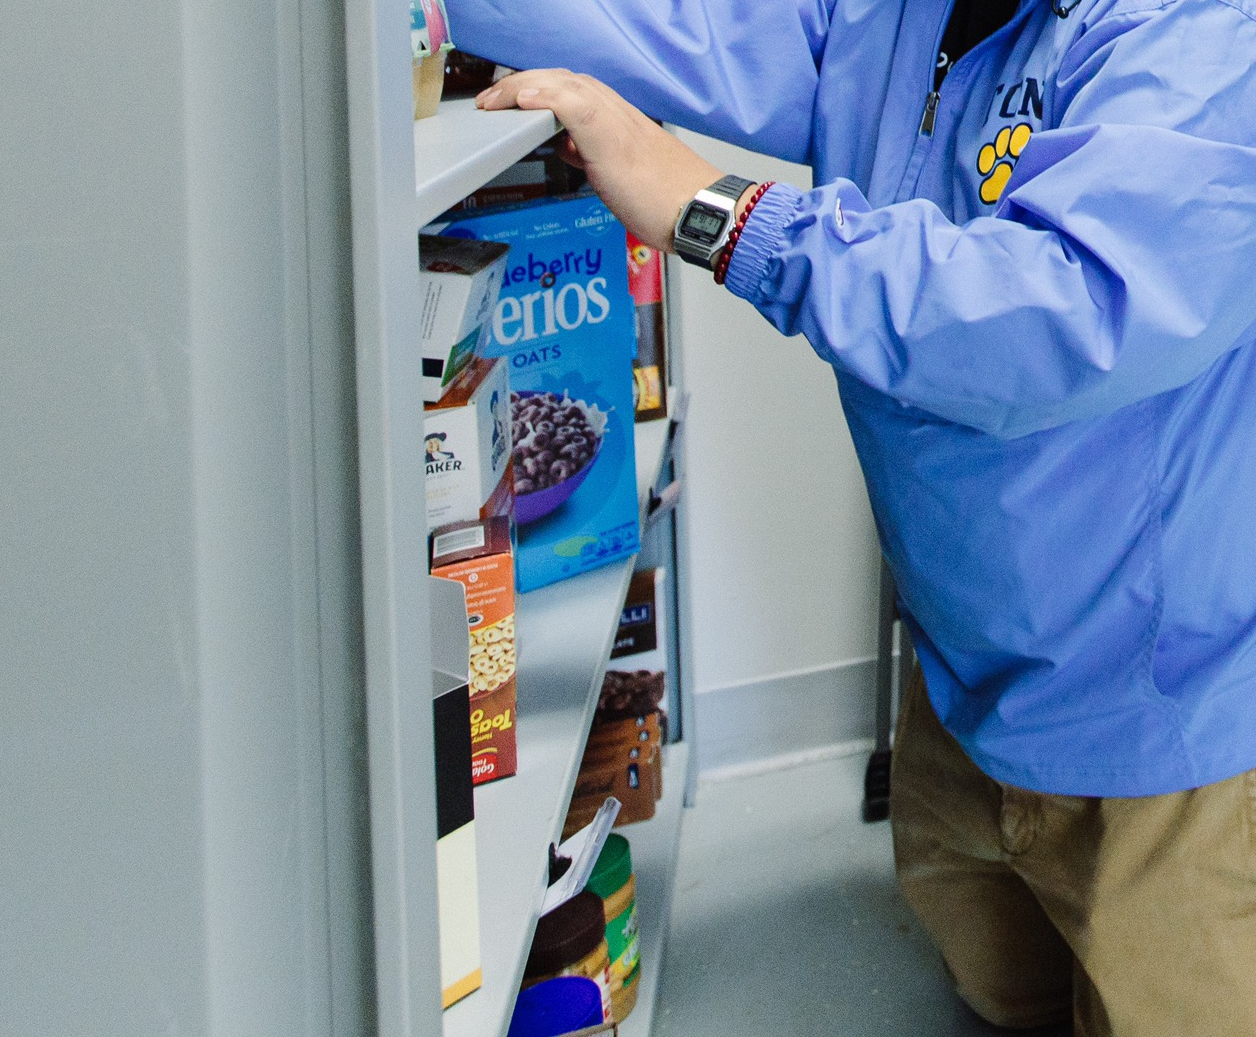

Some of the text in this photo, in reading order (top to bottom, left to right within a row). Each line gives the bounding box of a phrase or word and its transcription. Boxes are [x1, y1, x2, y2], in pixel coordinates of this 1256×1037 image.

[574, 216, 603, 229] Gluten
[512, 344, 562, 370] OATS
[425, 460, 462, 476] AKER
[471, 708, 513, 737] Toas
